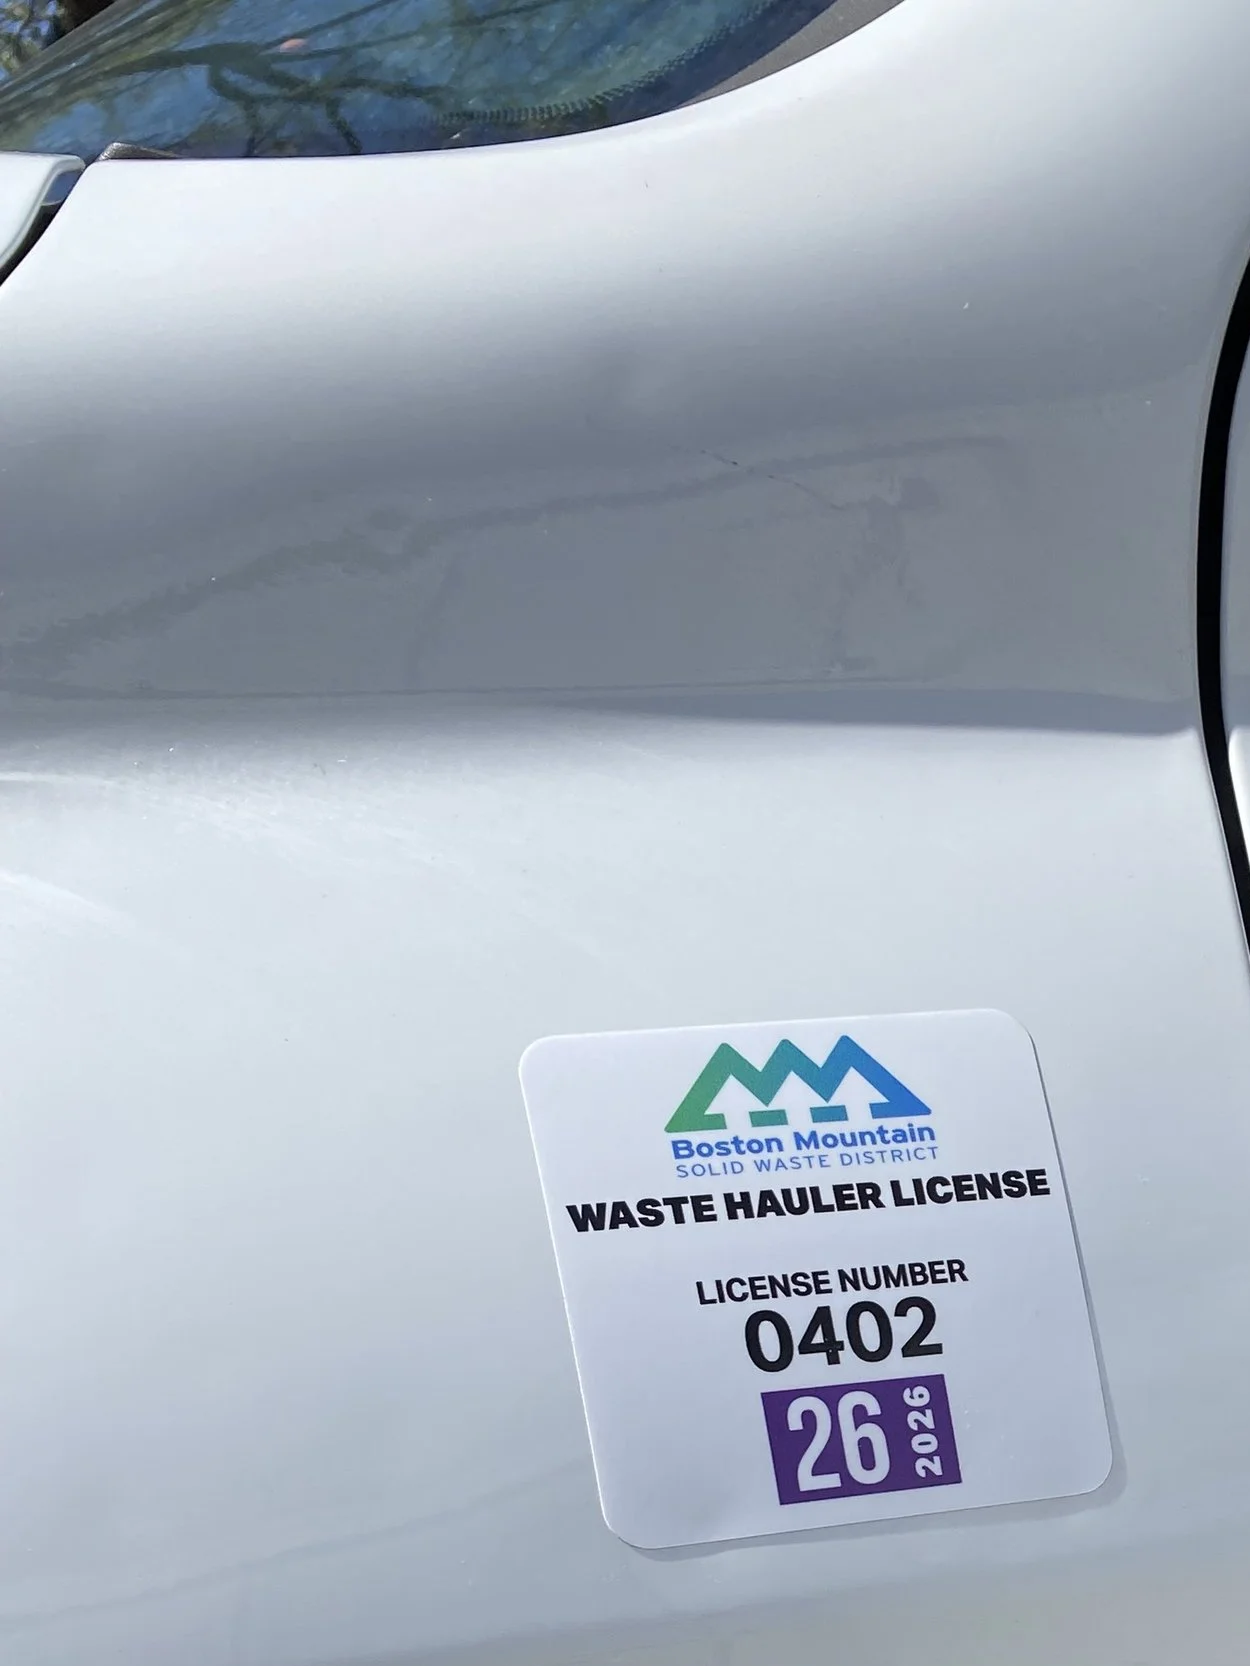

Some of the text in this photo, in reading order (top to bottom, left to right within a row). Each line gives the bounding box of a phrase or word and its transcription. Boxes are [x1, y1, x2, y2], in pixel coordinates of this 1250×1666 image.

[671, 1123, 936, 1160] Boston Mountain
[676, 1146, 939, 1179] SOLID WASTE DISTRICT
[566, 1169, 1051, 1232] WASTE HAULER LICENSE
[695, 1259, 969, 1305] LICENSE NUMBER
[744, 1296, 944, 1373] 0402
[786, 1391, 891, 1492] 26
[902, 1384, 945, 1478] 2026
